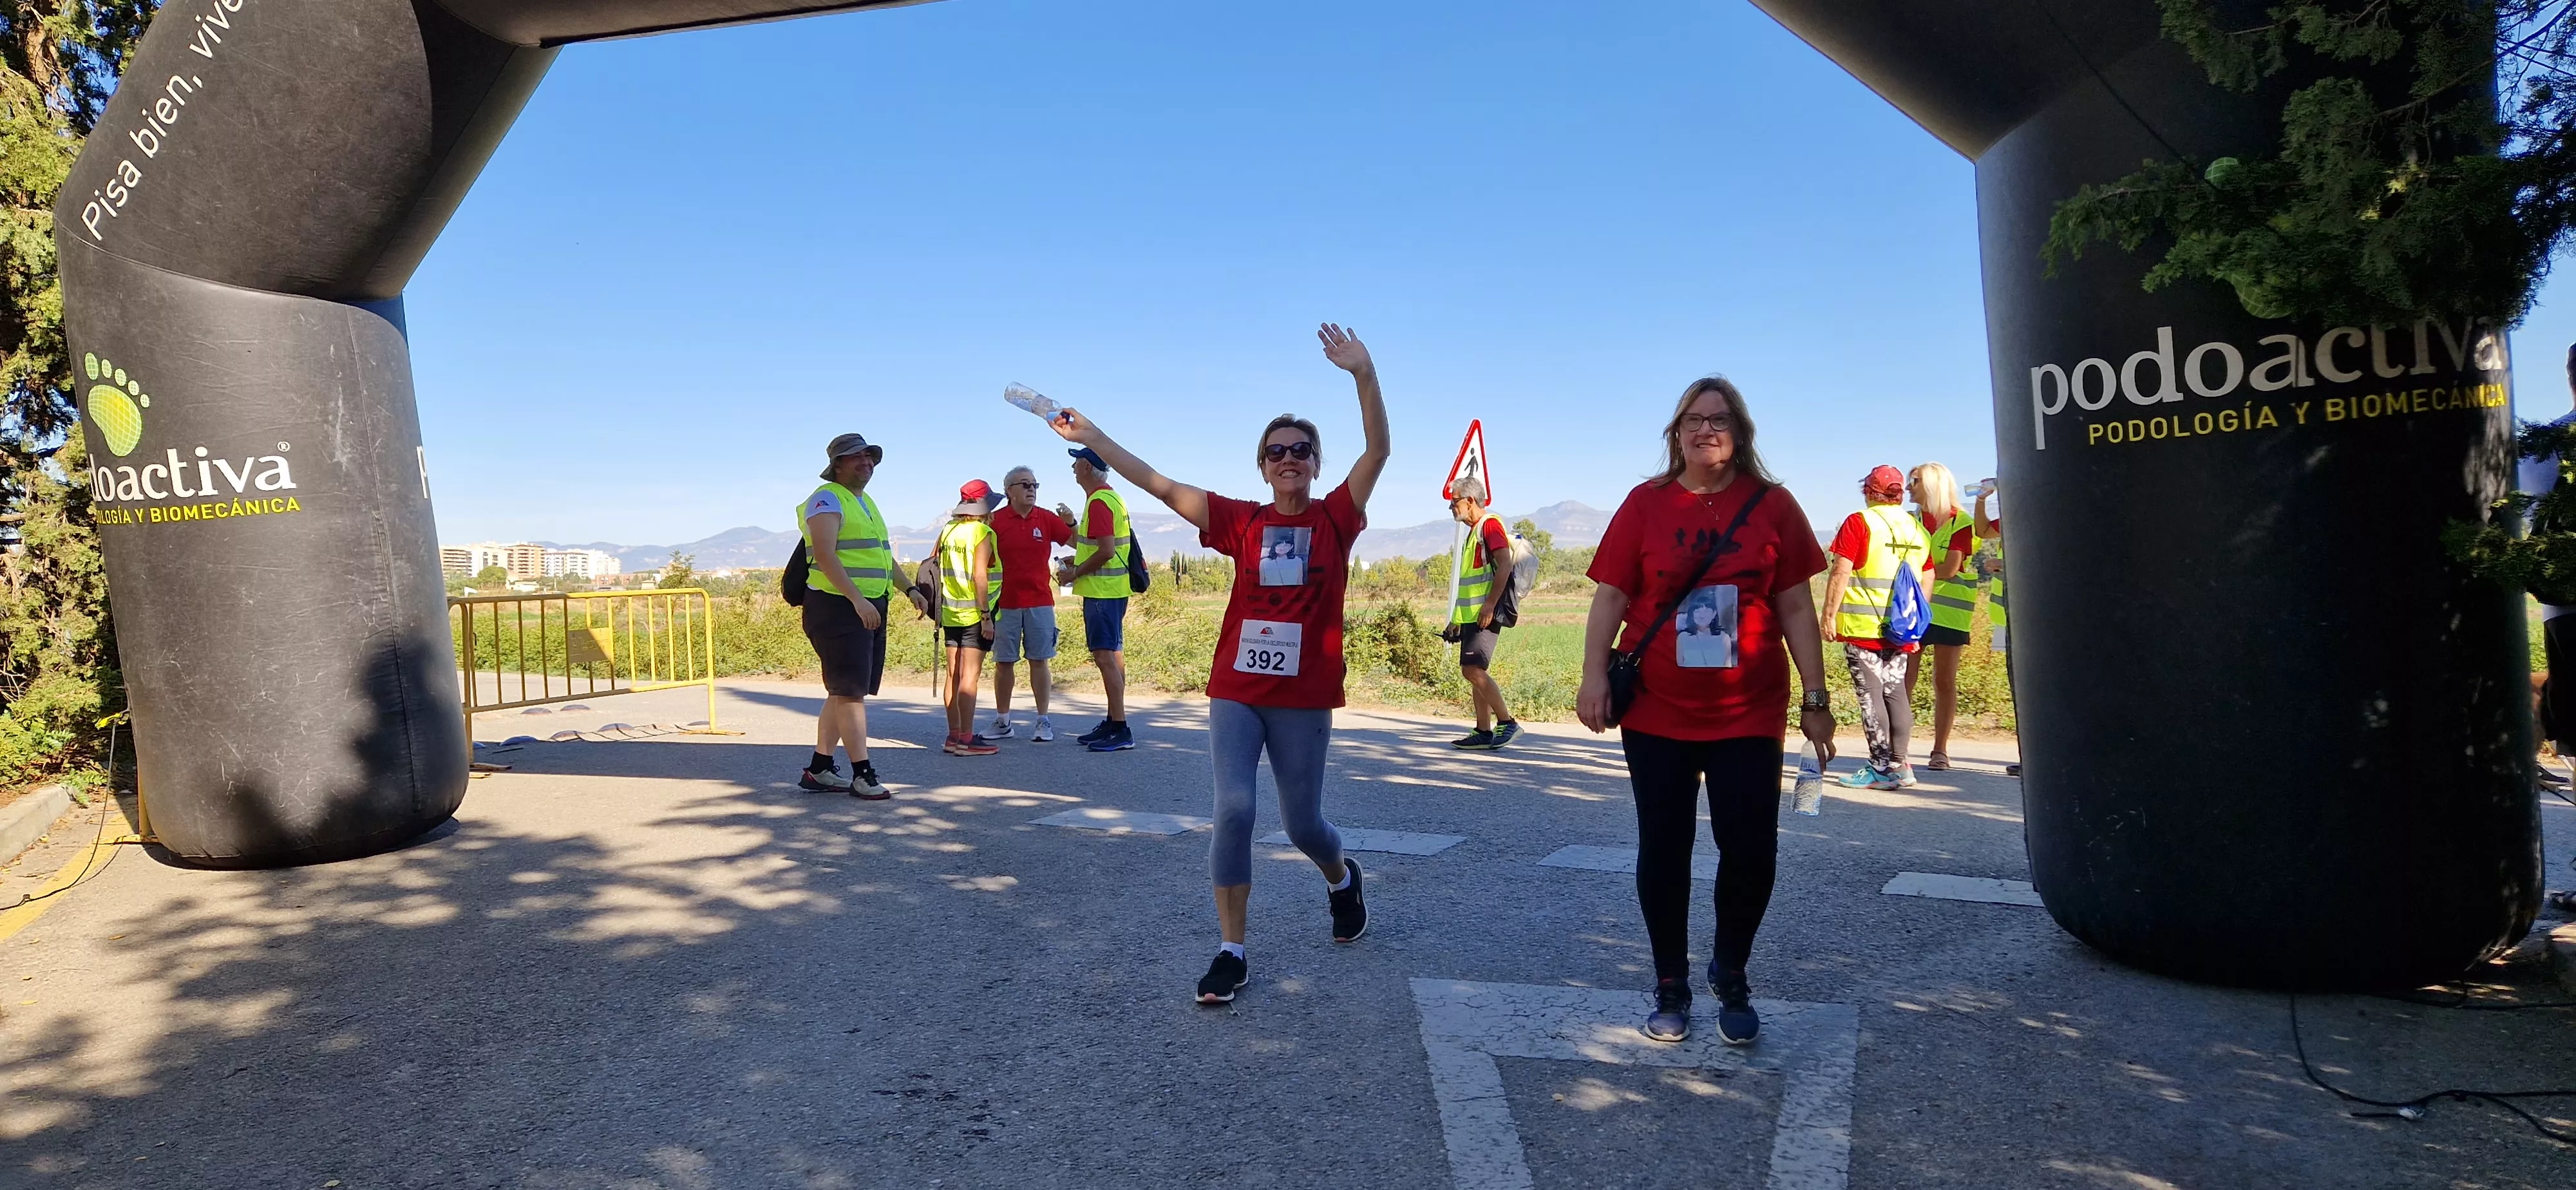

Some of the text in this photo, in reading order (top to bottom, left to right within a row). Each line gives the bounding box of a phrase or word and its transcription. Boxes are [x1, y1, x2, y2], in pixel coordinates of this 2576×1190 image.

[81, 160, 142, 241] Pisa
[129, 75, 203, 158] bien,
[2031, 316, 2506, 450] podoactiva
[2088, 380, 2507, 446] PODOLOGÍA Y BIOMECÁNICA
[134, 508, 144, 523] Y
[149, 496, 301, 523] BIOMECÁNICA
[1246, 648, 1286, 672] 392
